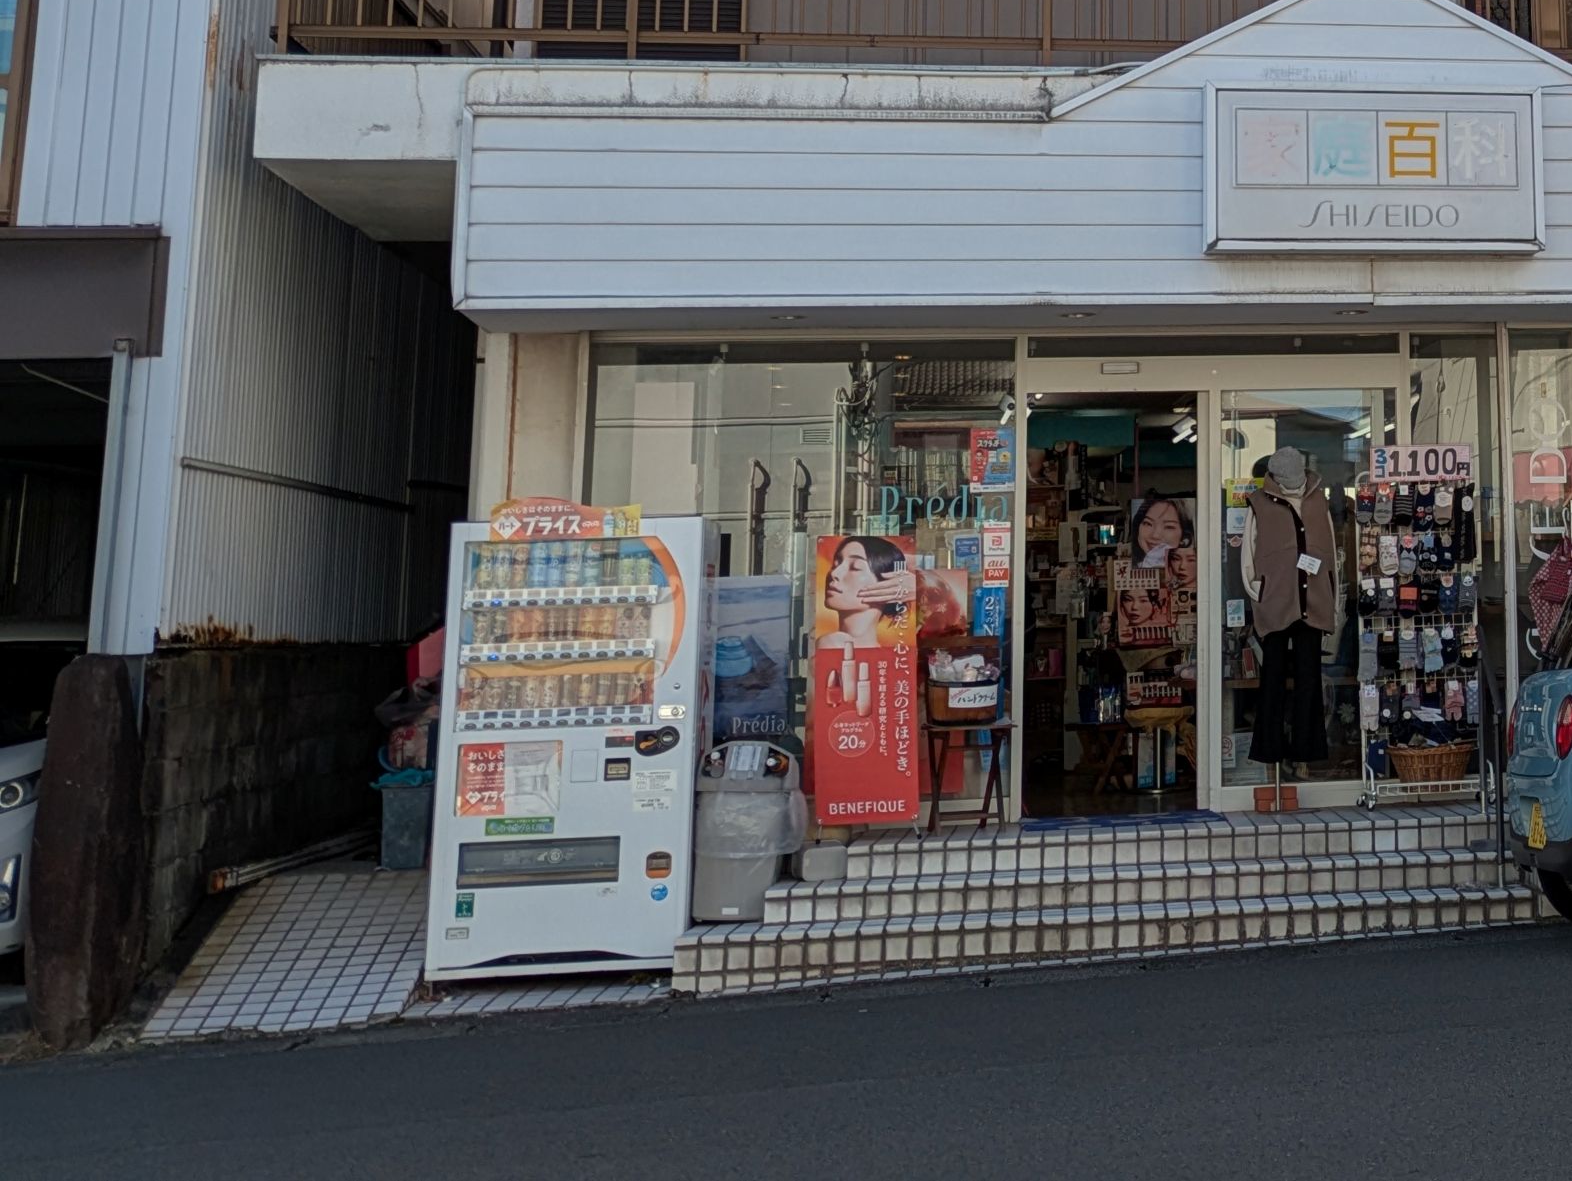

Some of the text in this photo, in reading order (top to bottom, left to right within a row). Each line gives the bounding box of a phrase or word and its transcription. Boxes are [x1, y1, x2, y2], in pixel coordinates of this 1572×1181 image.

[1243, 117, 1506, 181] 庭百科
[1299, 200, 1459, 228] SHISEIDO
[1388, 447, 1470, 477] 1,100円
[880, 482, 1009, 526] Prédia
[523, 515, 581, 536] プライス
[987, 560, 1006, 568] au
[988, 569, 1005, 577] PAY
[732, 714, 785, 734] Prédia
[838, 734, 866, 749] 20分
[829, 800, 905, 815] BENEFIQUE
